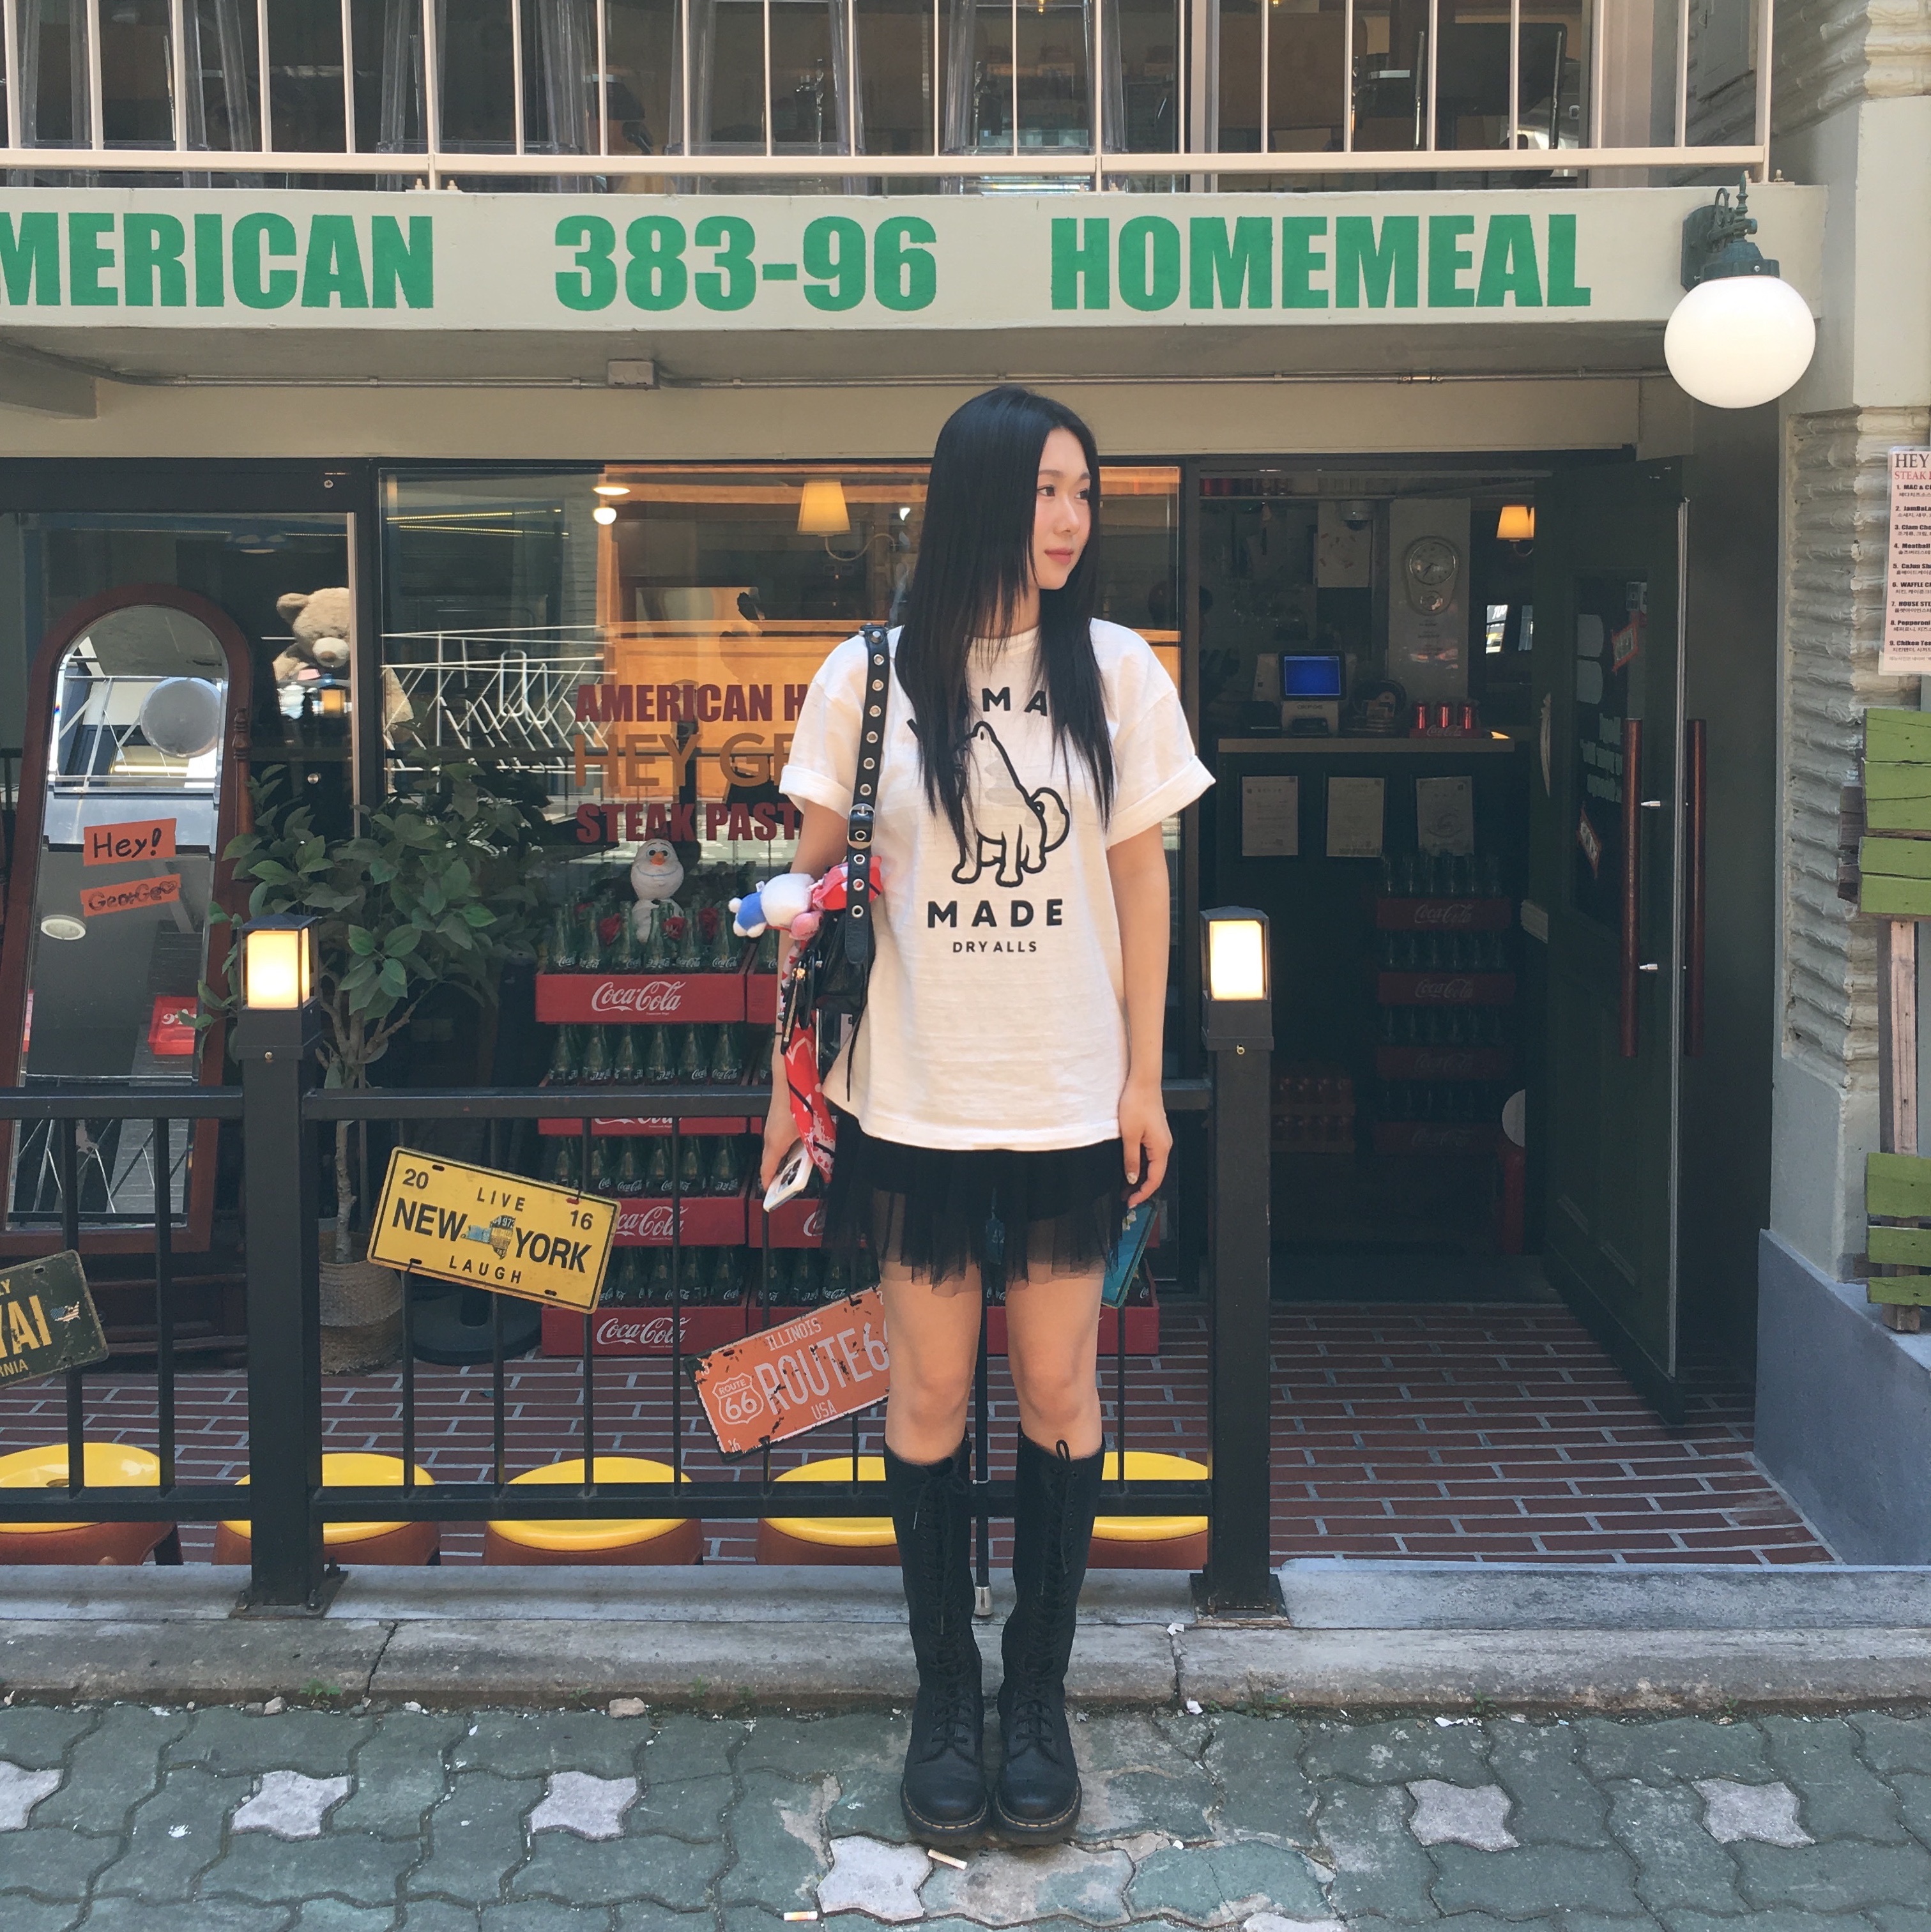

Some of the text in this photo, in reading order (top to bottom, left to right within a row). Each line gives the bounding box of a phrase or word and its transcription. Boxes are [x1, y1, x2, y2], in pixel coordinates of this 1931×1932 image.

[554, 215, 937, 312] 383-96
[1051, 214, 1591, 311] HOMEMEAL
[1895, 453, 1930, 468] HEY
[1894, 471, 1927, 480] STEAK
[576, 684, 772, 722] AMERICAN
[576, 733, 702, 787] HEY
[576, 802, 696, 843] STEAK
[94, 828, 162, 858] Hey!
[927, 899, 1063, 928] MADE
[591, 981, 687, 1012] Coca-Cola
[402, 1168, 429, 1190] 20
[477, 1187, 526, 1212] LIVE
[570, 1209, 594, 1230] 16
[392, 1198, 593, 1274] NEW YORK
[449, 1255, 523, 1284] LAUGH
[0, 1295, 52, 1358] AI
[765, 1317, 823, 1351] ILLINOIS
[719, 1378, 747, 1396] ROUTE
[724, 1391, 758, 1420] 66
[811, 1399, 837, 1420] USA
